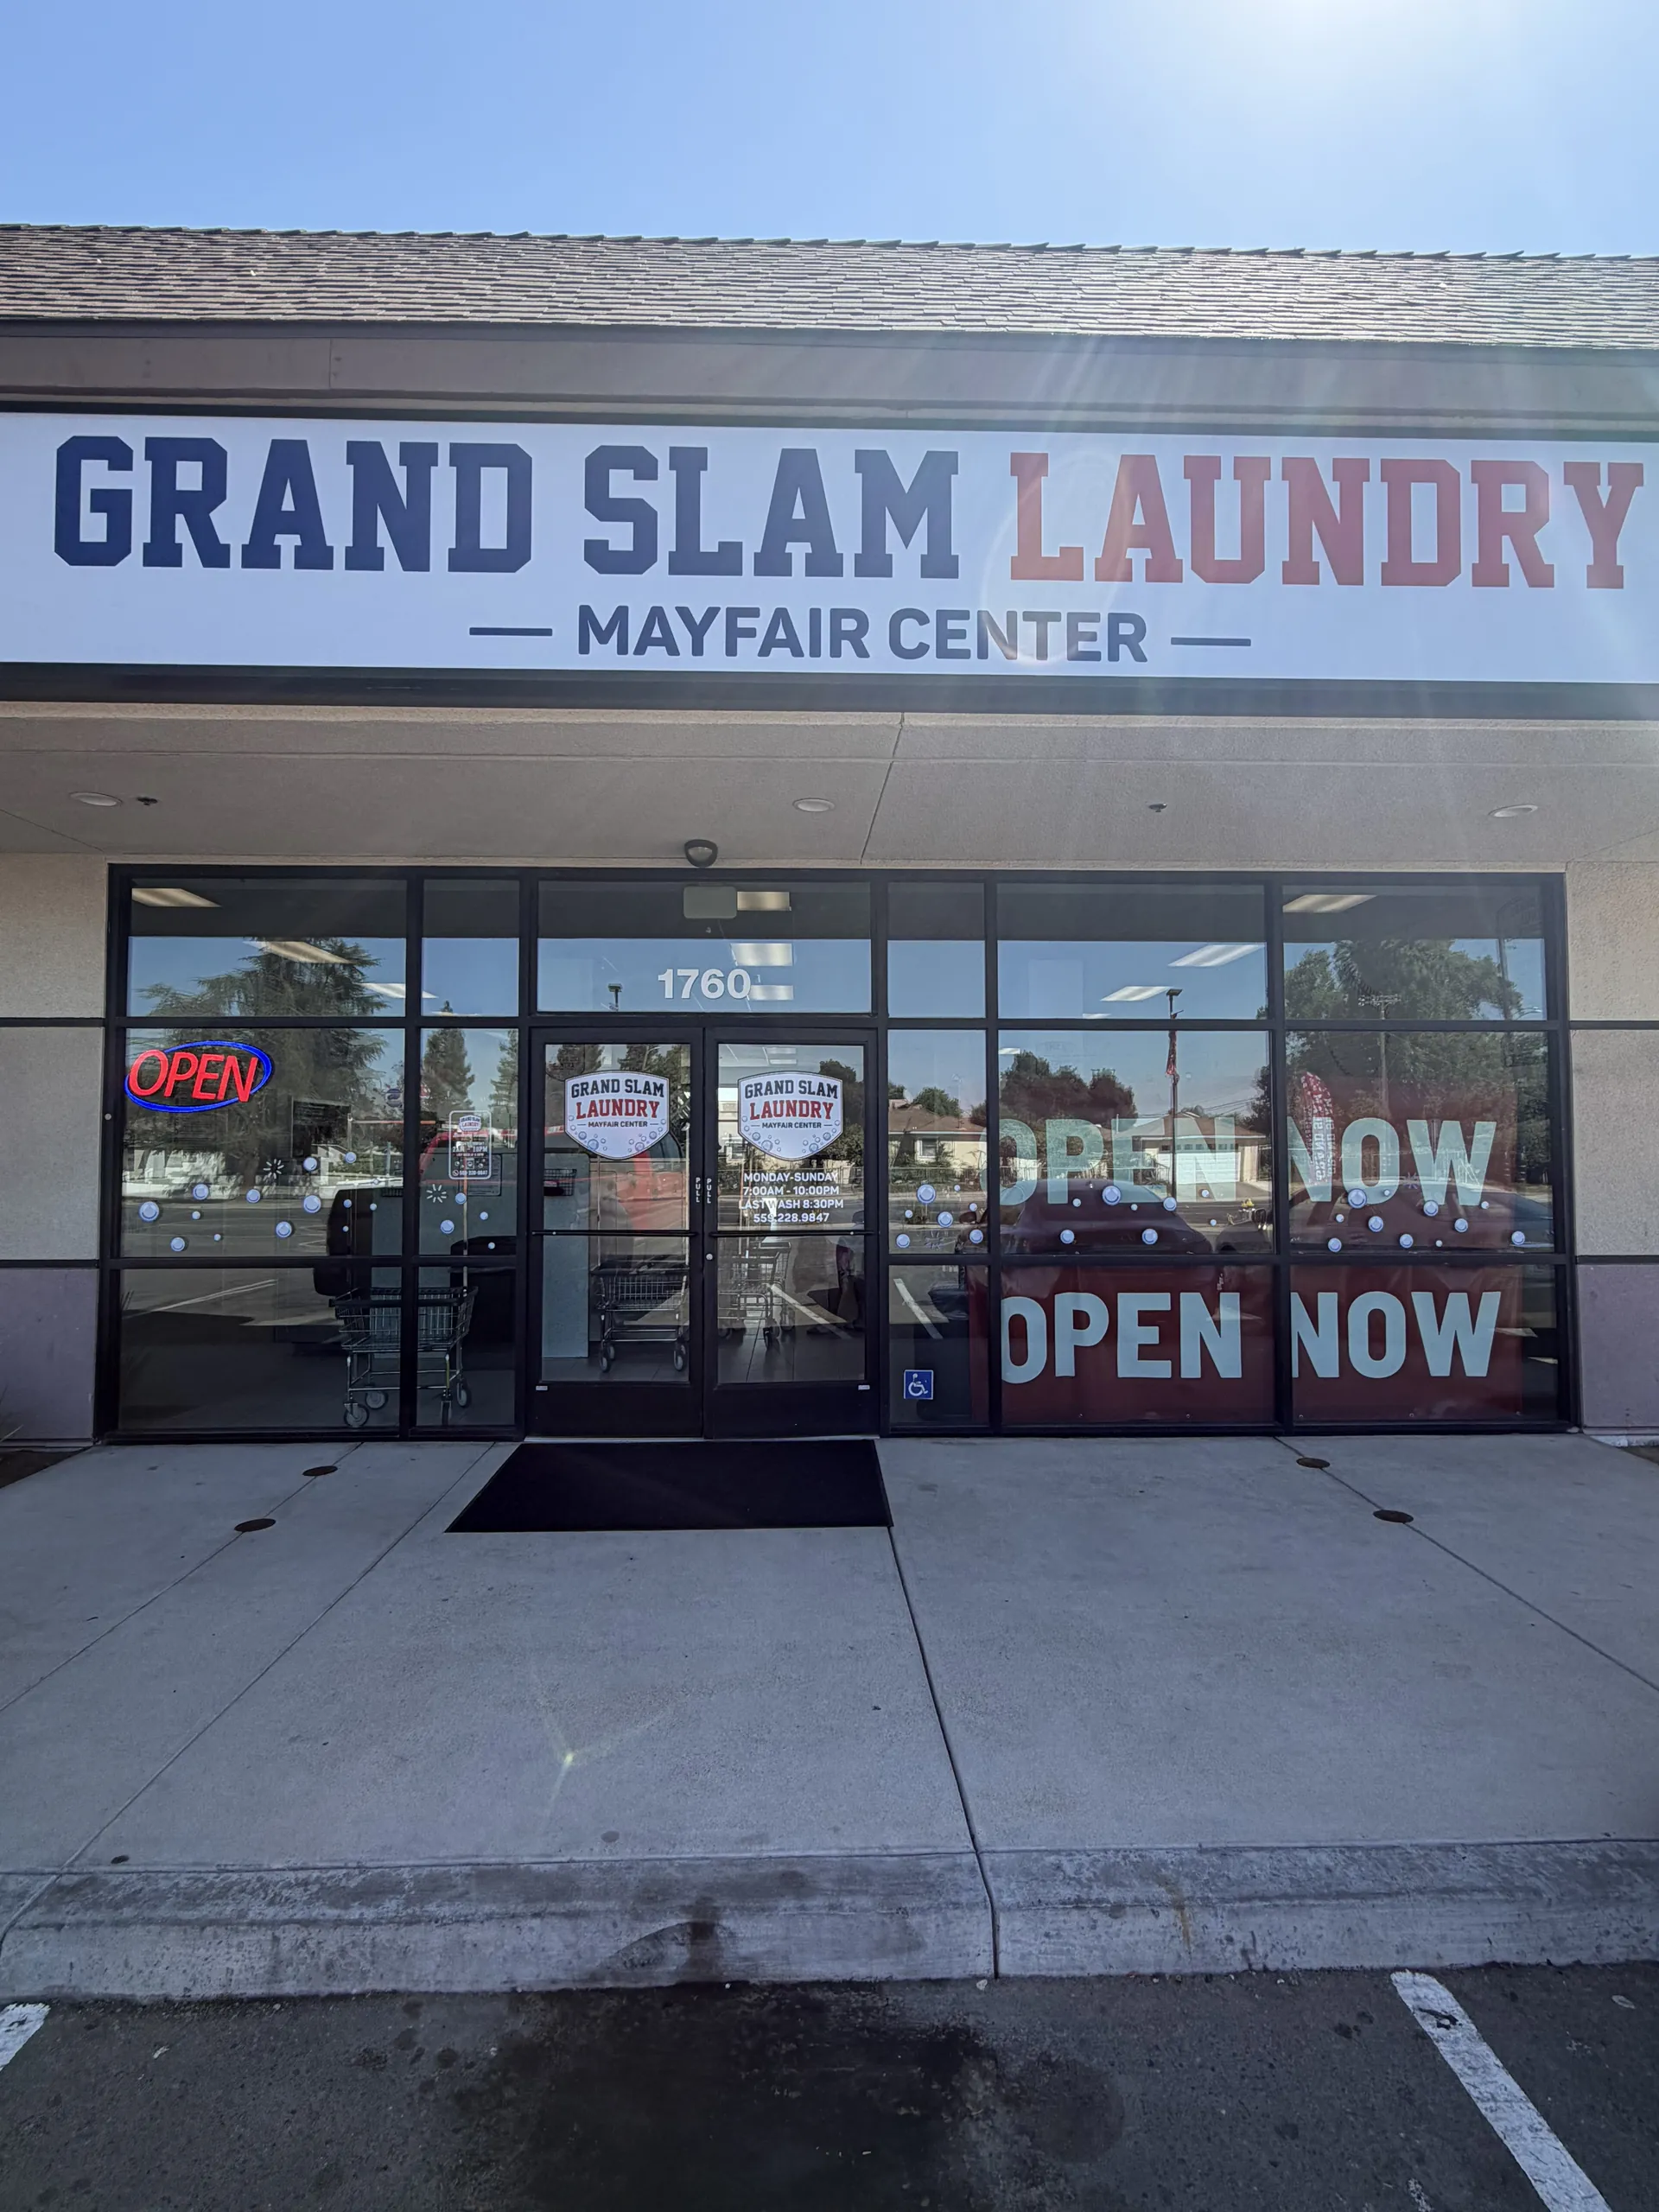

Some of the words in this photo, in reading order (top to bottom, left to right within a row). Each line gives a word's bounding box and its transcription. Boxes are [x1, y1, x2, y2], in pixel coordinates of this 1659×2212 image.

[54, 435, 533, 573] GRAND
[583, 444, 960, 579] SLAM
[1009, 452, 1643, 588] LAUNDRY
[577, 604, 870, 659] MAYFAIR
[888, 607, 1148, 663] CENTER
[658, 968, 752, 1000] 1760
[129, 1048, 258, 1103] OPEN
[571, 1079, 620, 1098] GRAND
[625, 1079, 664, 1097] SLAM
[745, 1080, 794, 1099] GRAND
[798, 1080, 838, 1099] SLAM
[576, 1099, 660, 1119] LAUNDRY
[750, 1100, 834, 1120] LAUNDRY
[980, 1117, 1236, 1206] OPEN
[1287, 1117, 1497, 1206] NOW
[744, 1173, 838, 1182] MONDAY-SUNDAY
[743, 1186, 784, 1196] 7:00AM
[793, 1186, 840, 1196] 10:00PM
[739, 1199, 765, 1209] LAST
[766, 1199, 800, 1209] WASH
[803, 1199, 843, 1209] 8:30PM
[753, 1213, 830, 1223] 559.228.9847
[1001, 1291, 1243, 1383] OPEN
[1291, 1291, 1502, 1378] NOW
